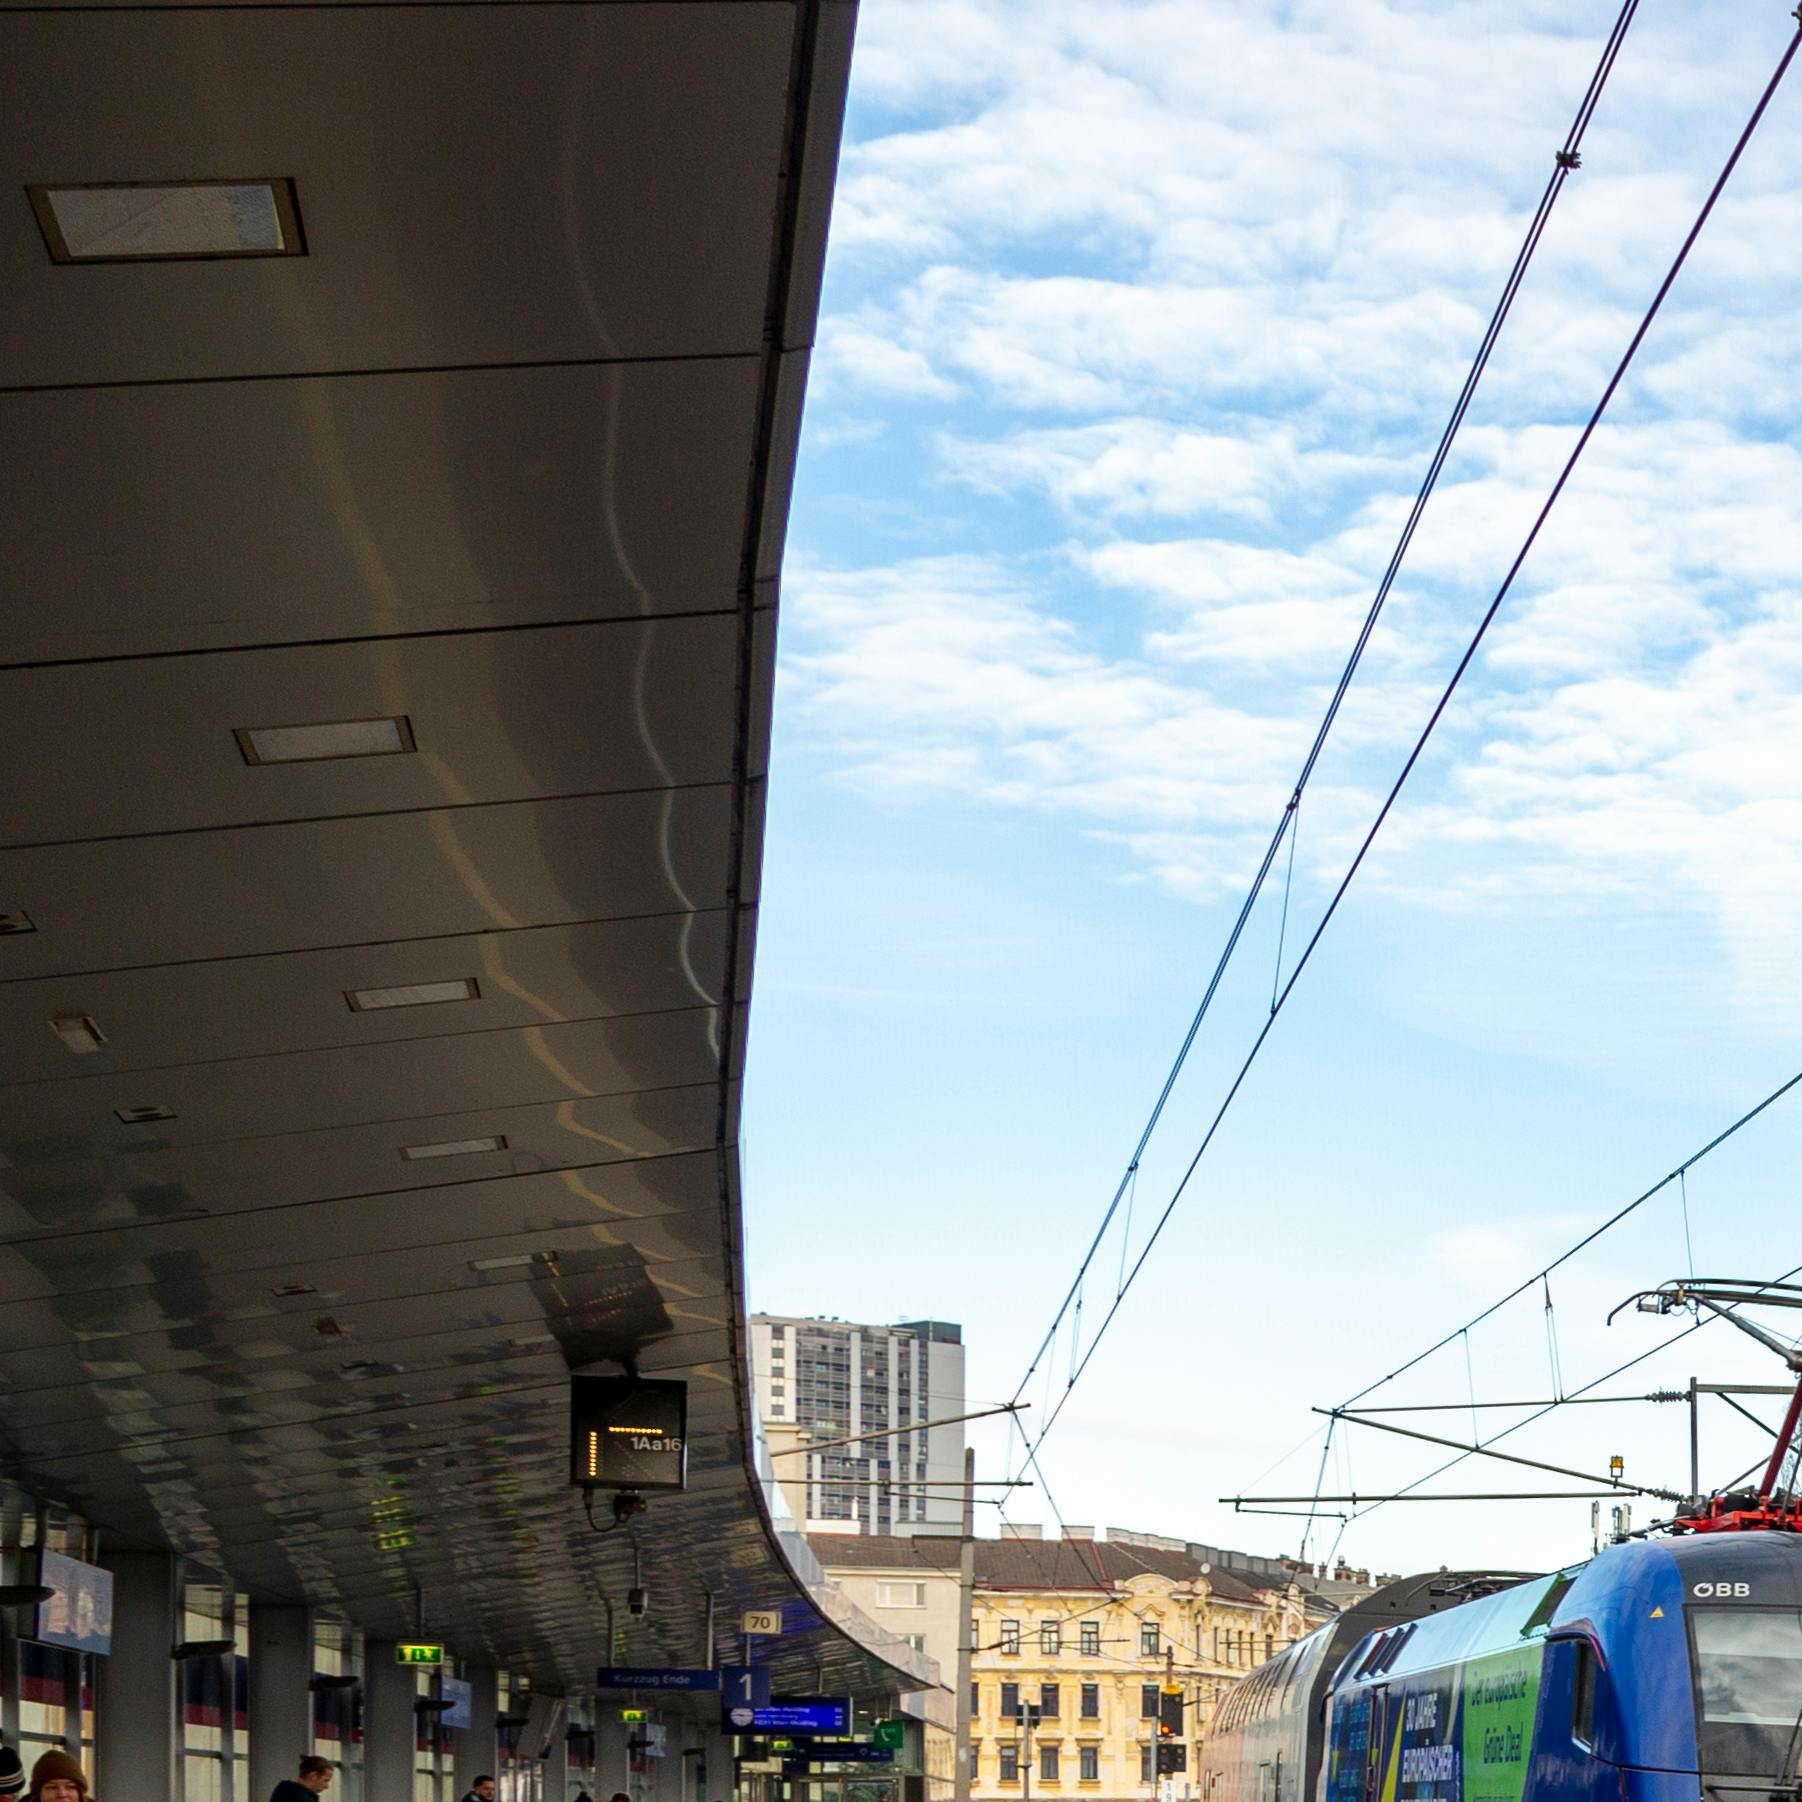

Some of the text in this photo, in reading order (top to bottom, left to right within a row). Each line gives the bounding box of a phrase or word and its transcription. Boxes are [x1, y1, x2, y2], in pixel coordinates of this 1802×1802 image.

[1692, 1581, 1751, 1598] ÖBB
[749, 1616, 771, 1629] 70
[662, 1674, 691, 1685] Ende
[738, 1673, 753, 1701] 1
